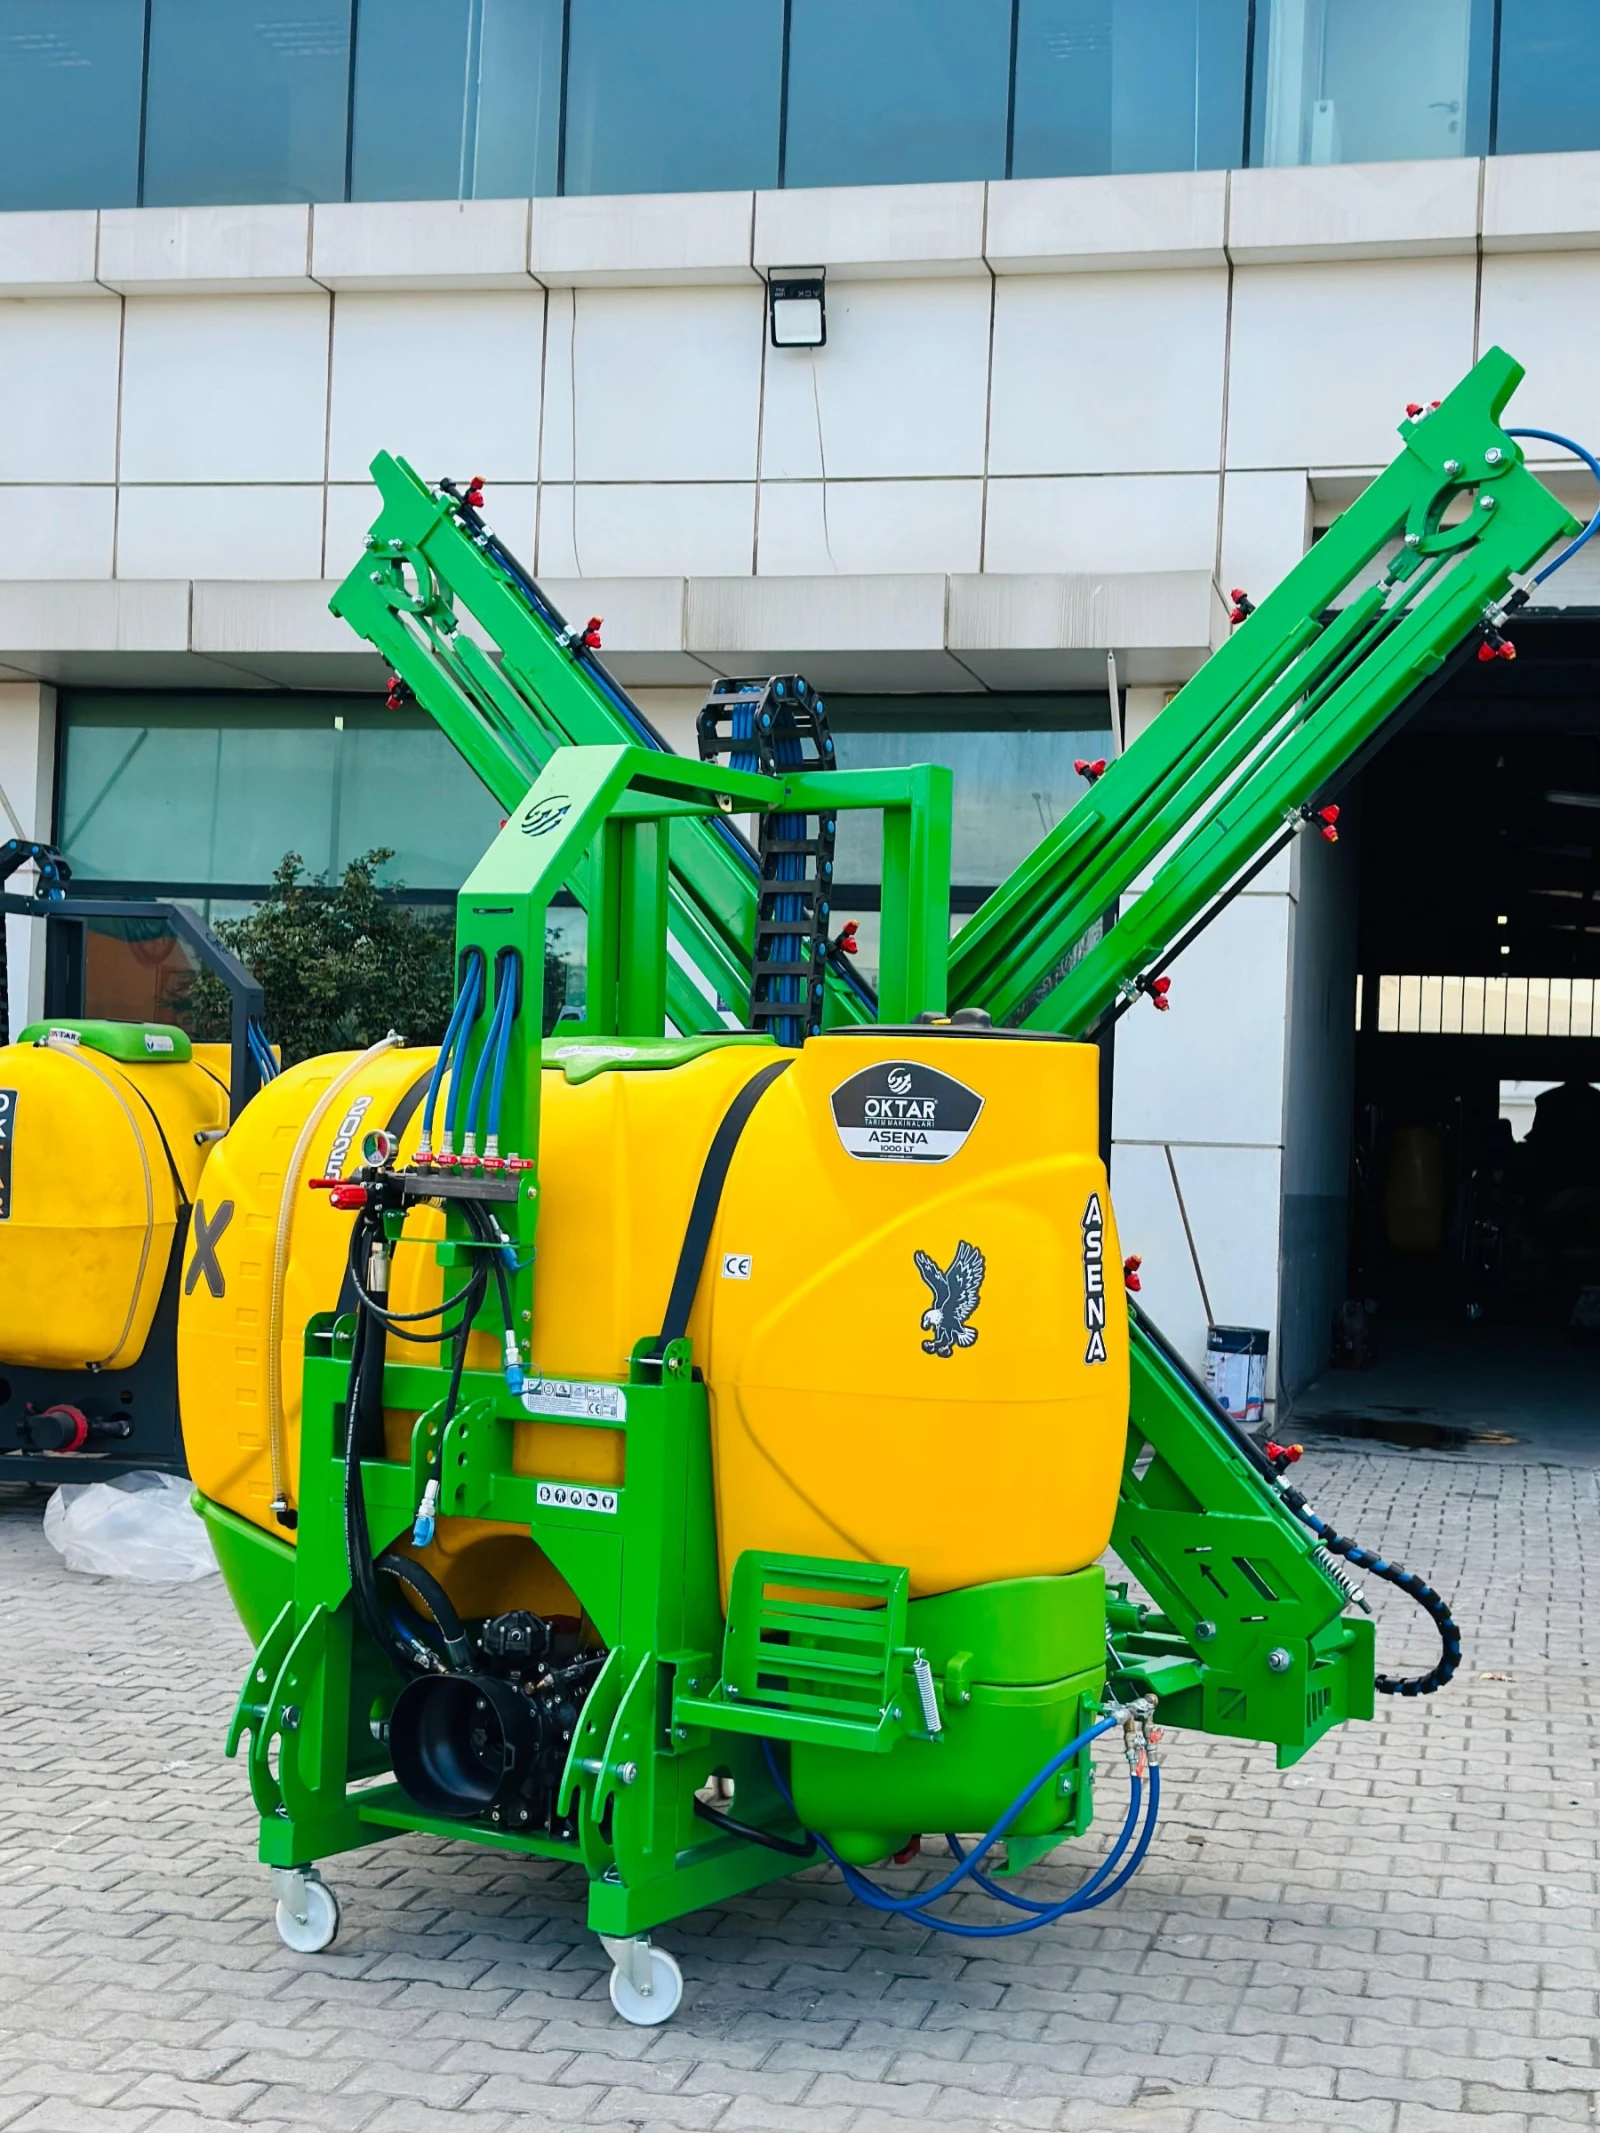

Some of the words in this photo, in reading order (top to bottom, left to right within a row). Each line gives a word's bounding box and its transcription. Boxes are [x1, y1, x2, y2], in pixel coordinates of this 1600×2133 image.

[864, 1099, 936, 1119] OKTAR
[324, 1096, 373, 1181] 2025
[868, 1130, 929, 1144] ASENA
[903, 1145, 915, 1153] LT
[1084, 1195, 1106, 1361] ASENA
